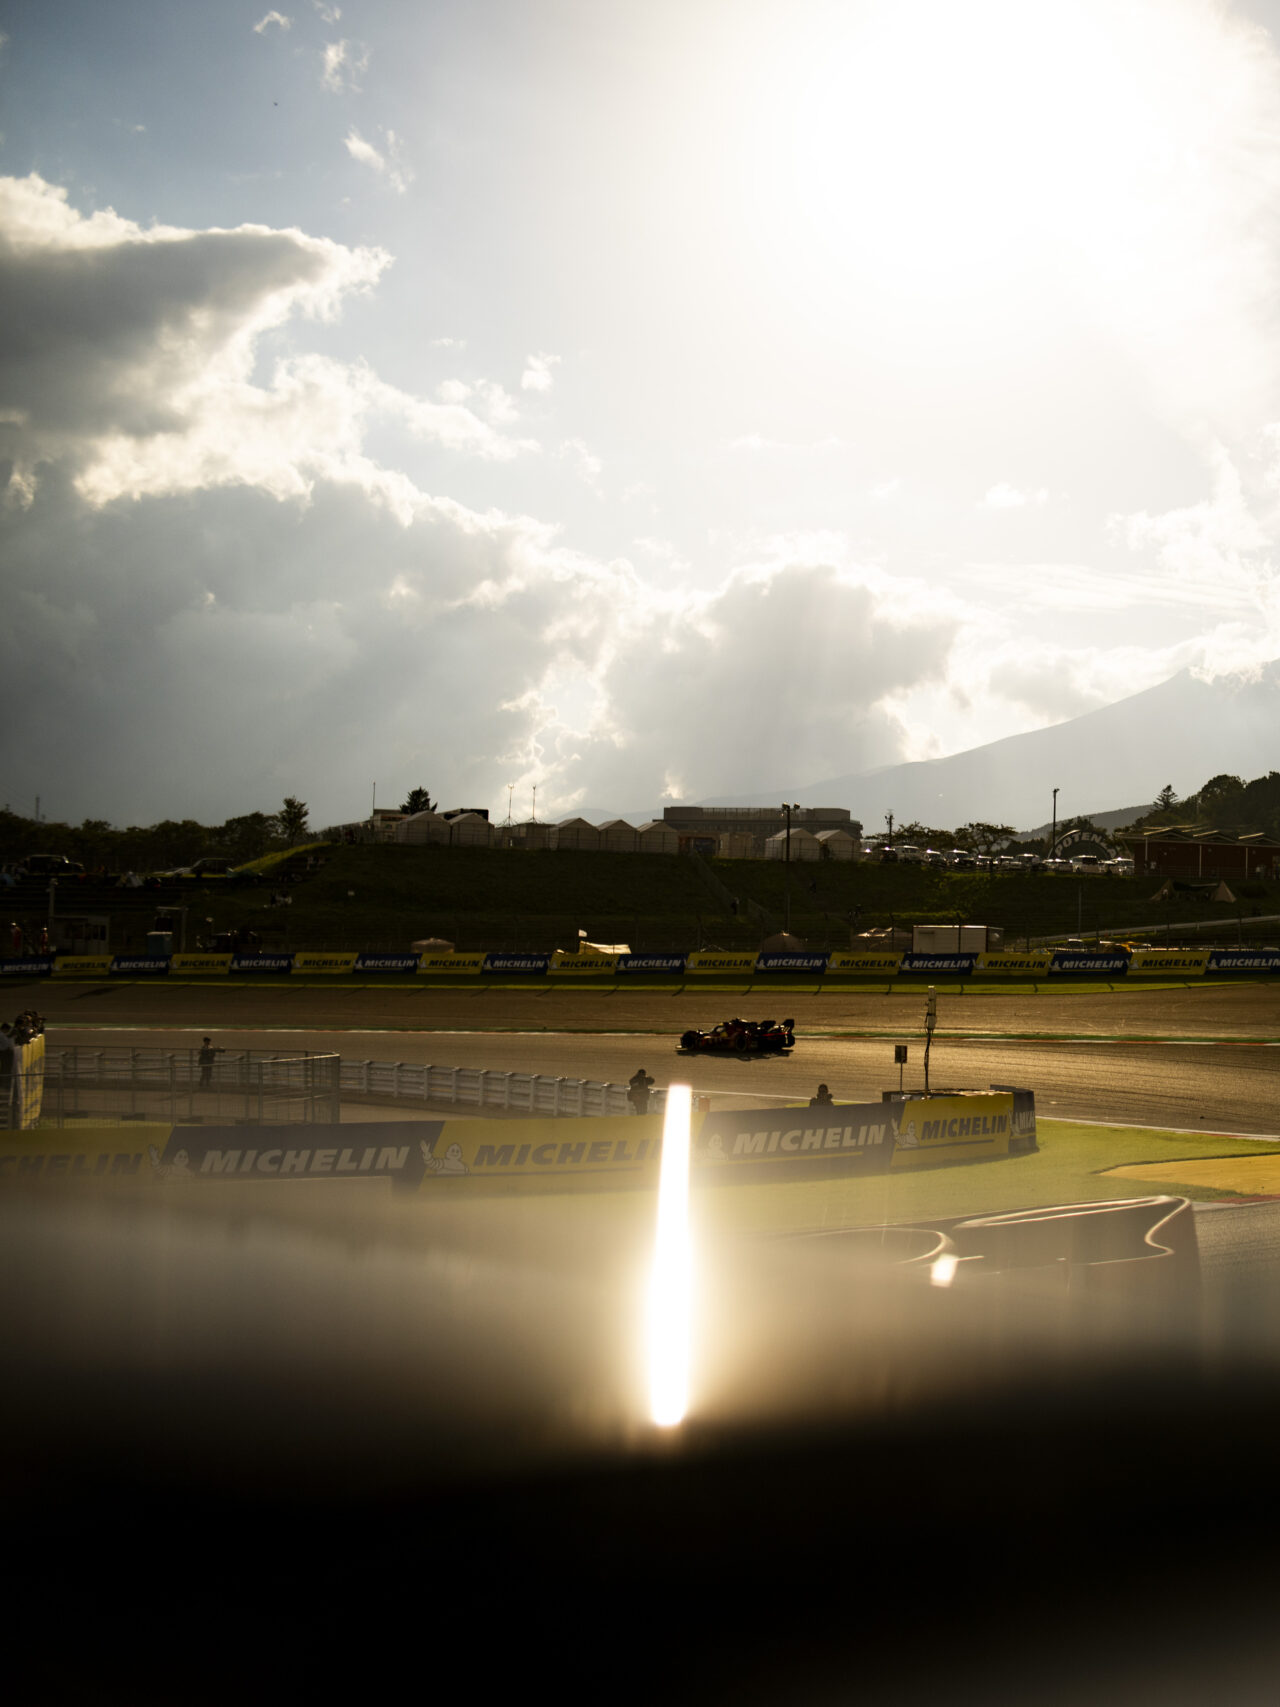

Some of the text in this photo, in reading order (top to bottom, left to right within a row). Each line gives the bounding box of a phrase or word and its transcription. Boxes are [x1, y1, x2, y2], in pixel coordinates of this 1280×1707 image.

[2, 962, 50, 972] MICHELIN
[63, 960, 107, 969] MICHELIN
[121, 959, 166, 969] MICHELIN
[180, 959, 226, 967] MICHELIN
[240, 959, 288, 968] MICHELIN
[303, 959, 351, 967] MICHELIN
[362, 959, 414, 968] MICHELIN
[429, 959, 480, 967] MICHELIN
[493, 959, 545, 968] MICHELIN
[560, 959, 613, 967] MICHELIN
[625, 959, 681, 968] MICHELIN
[698, 959, 752, 967] MICHELIN
[767, 958, 823, 967] MICHELIN
[840, 959, 896, 967] MICHELIN
[912, 959, 969, 968] MICHELIN
[988, 960, 1046, 969] MICHELIN
[1062, 960, 1123, 969] MICHELIN
[1142, 959, 1203, 967] MICHELIN
[921, 1114, 1007, 1140] MICHELIN
[732, 1124, 886, 1155] MICHELIN
[200, 1147, 409, 1173] MICHELIN
